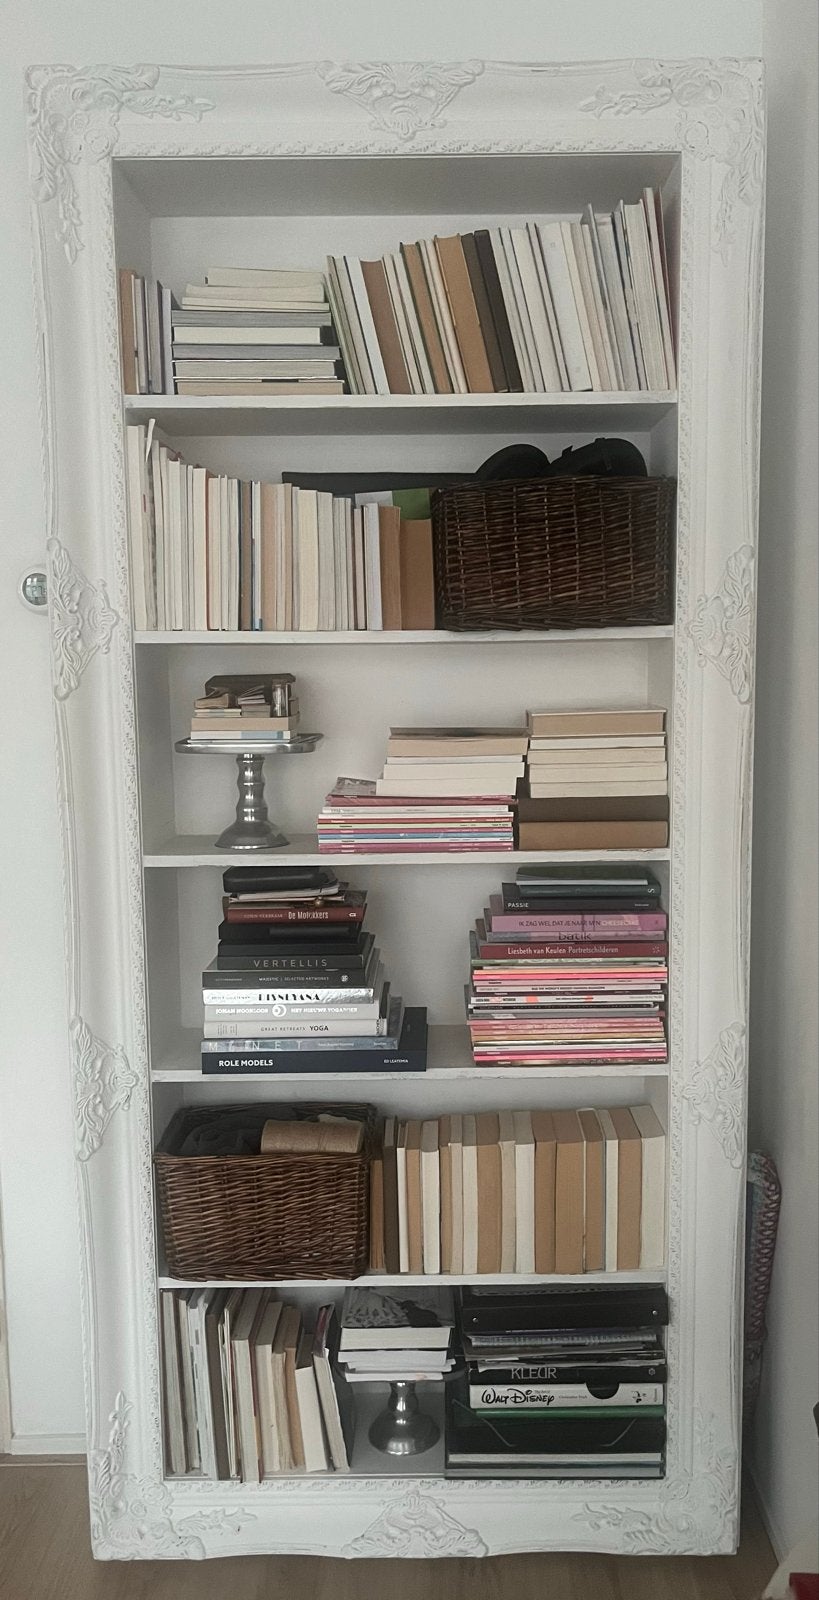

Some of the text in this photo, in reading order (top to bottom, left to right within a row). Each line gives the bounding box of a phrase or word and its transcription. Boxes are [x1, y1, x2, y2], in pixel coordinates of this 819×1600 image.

[288, 911, 296, 920] De
[507, 947, 532, 955] Liesbeth
[545, 946, 566, 954] Keulen
[568, 946, 619, 954] Portretschilderen
[253, 959, 328, 968] VERTELLIS
[208, 1040, 303, 1051] MNET
[218, 1059, 274, 1068] ROLE MODELS
[511, 1367, 557, 1379] KLEUR
